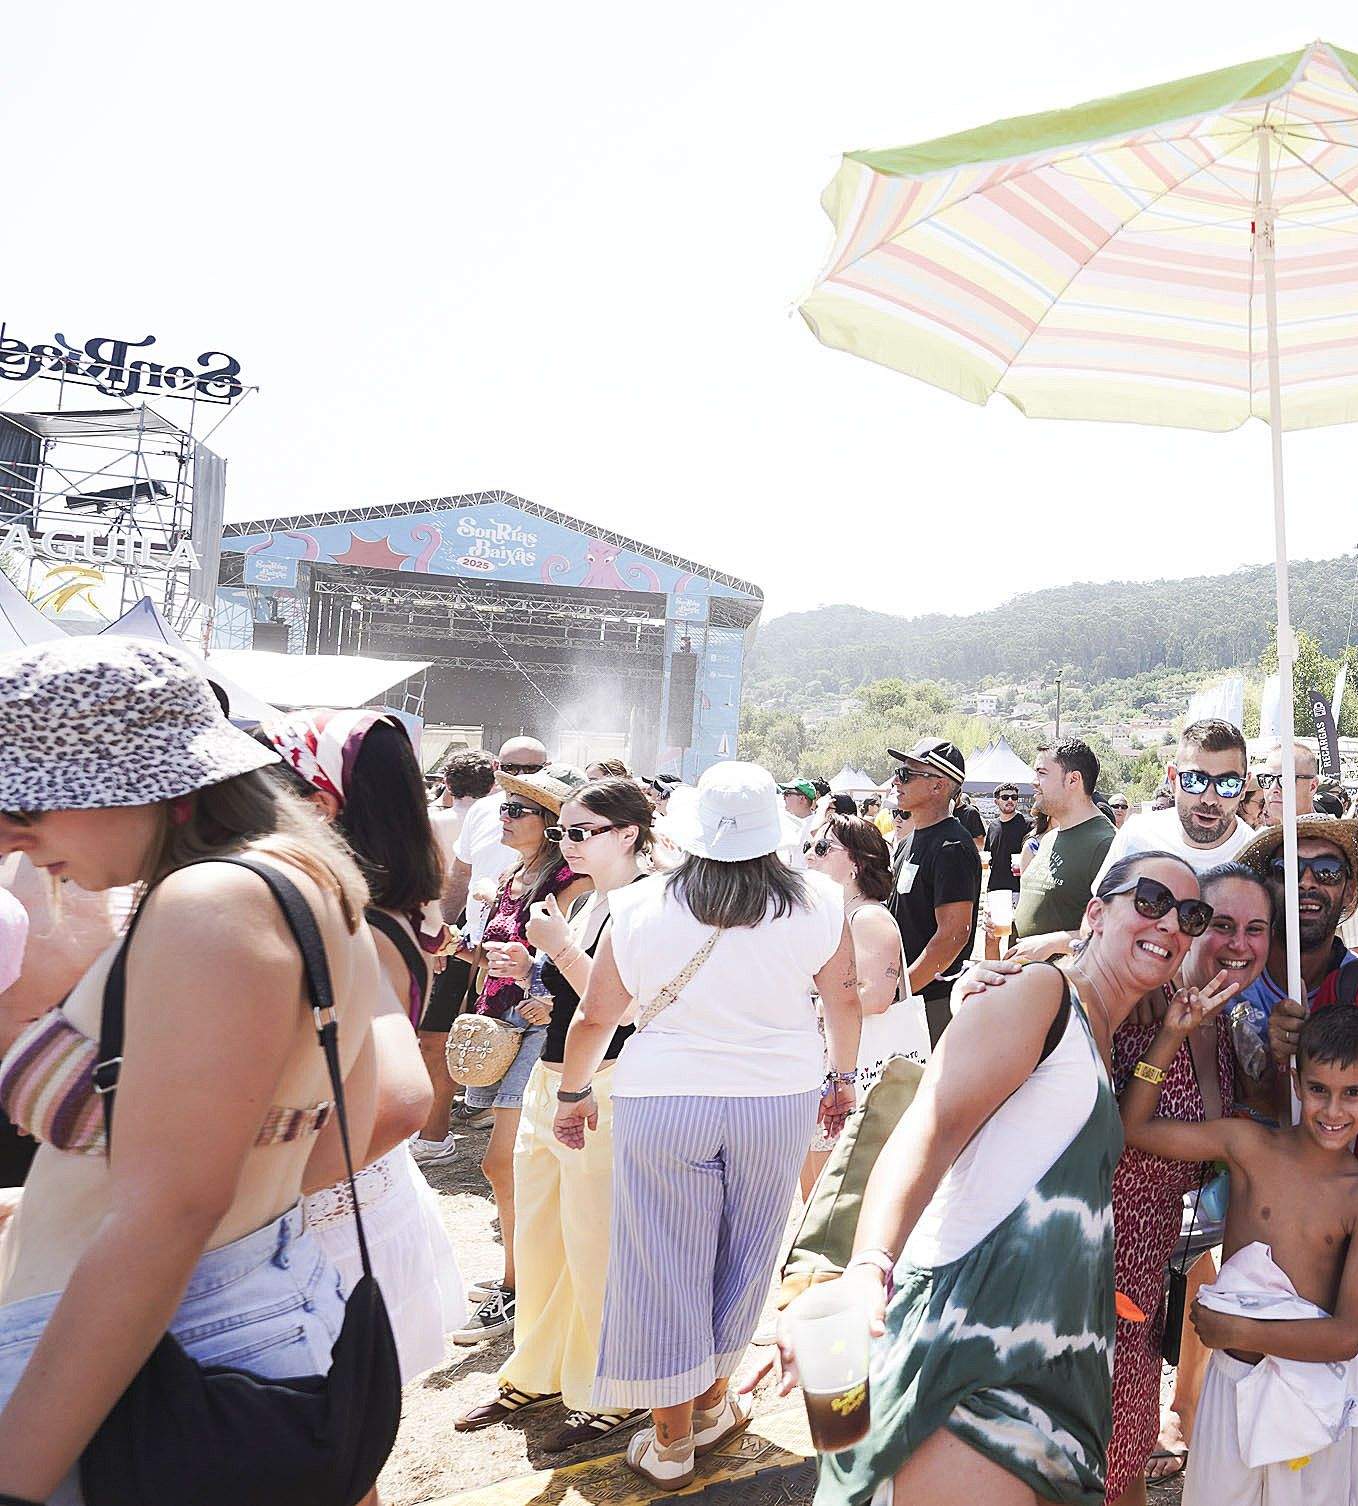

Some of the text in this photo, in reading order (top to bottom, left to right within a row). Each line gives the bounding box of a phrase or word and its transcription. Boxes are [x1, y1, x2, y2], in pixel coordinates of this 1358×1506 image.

[462, 558, 490, 570] 2025
[468, 539, 537, 566] Baixas
[1316, 721, 1332, 768] RECARGAS
